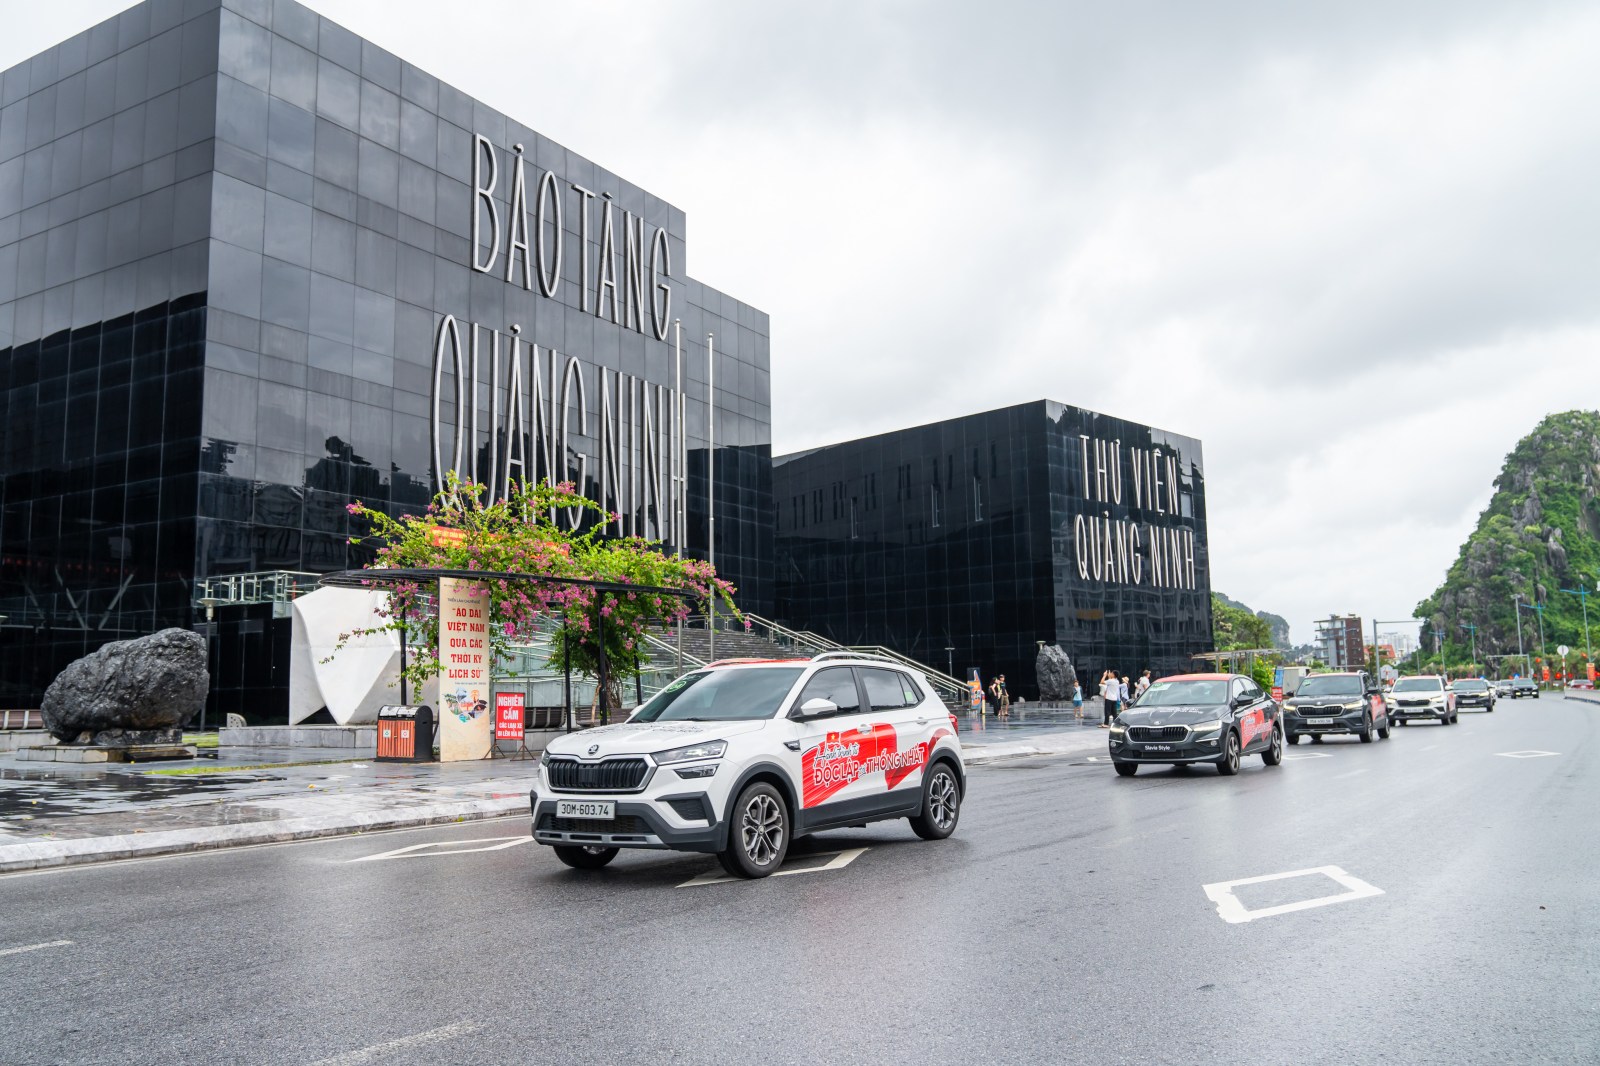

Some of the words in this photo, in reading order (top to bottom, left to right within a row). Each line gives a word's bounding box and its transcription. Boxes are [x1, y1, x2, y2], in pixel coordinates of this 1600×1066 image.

[473, 133, 561, 298] BẢO
[571, 184, 671, 341] TÀNG
[431, 314, 587, 530] QUẢNG
[601, 366, 687, 548] NINH
[1131, 447, 1179, 516] VIỆN
[1074, 510, 1141, 585] QUẢNG
[1150, 525, 1196, 590] NINH
[469, 622, 485, 633] NAM
[450, 637, 467, 648] QUA
[448, 668, 469, 680] LỊCH
[503, 706, 519, 720] CẤM
[814, 762, 840, 786] ĐỘC
[867, 748, 900, 773] THỐNG
[561, 803, 609, 816] 30M-603.74
